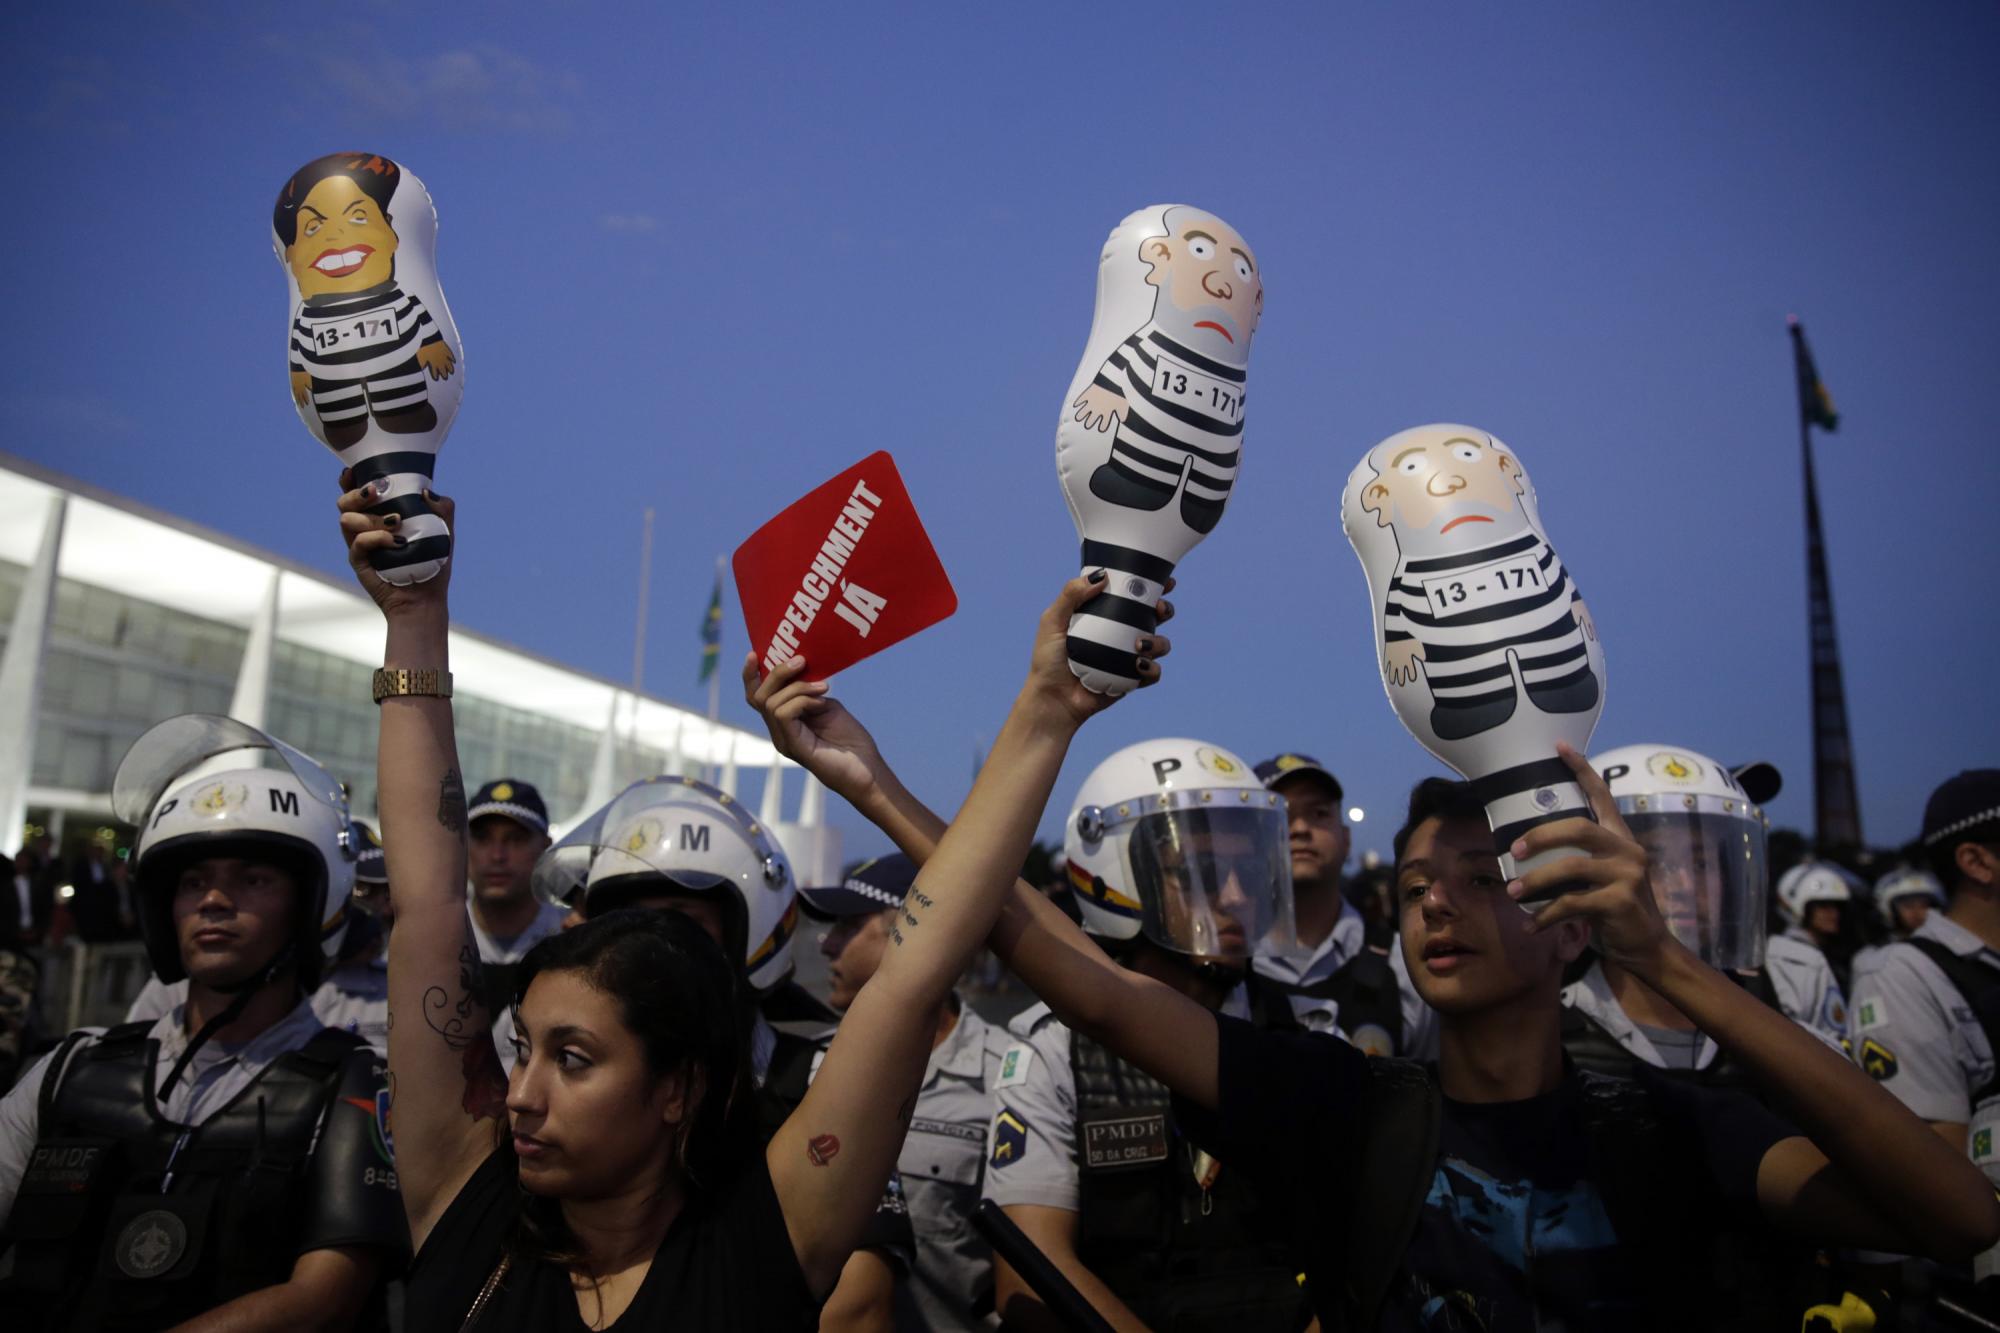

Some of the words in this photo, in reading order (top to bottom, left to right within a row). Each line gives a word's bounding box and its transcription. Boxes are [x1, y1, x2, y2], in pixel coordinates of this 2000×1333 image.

[833, 576, 888, 639] JÁ
[1152, 758, 1182, 786] P
[1602, 764, 1630, 791] P
[152, 799, 179, 830] P
[268, 788, 299, 817] M
[680, 823, 710, 853] M
[1091, 1120, 1160, 1142] PMDF
